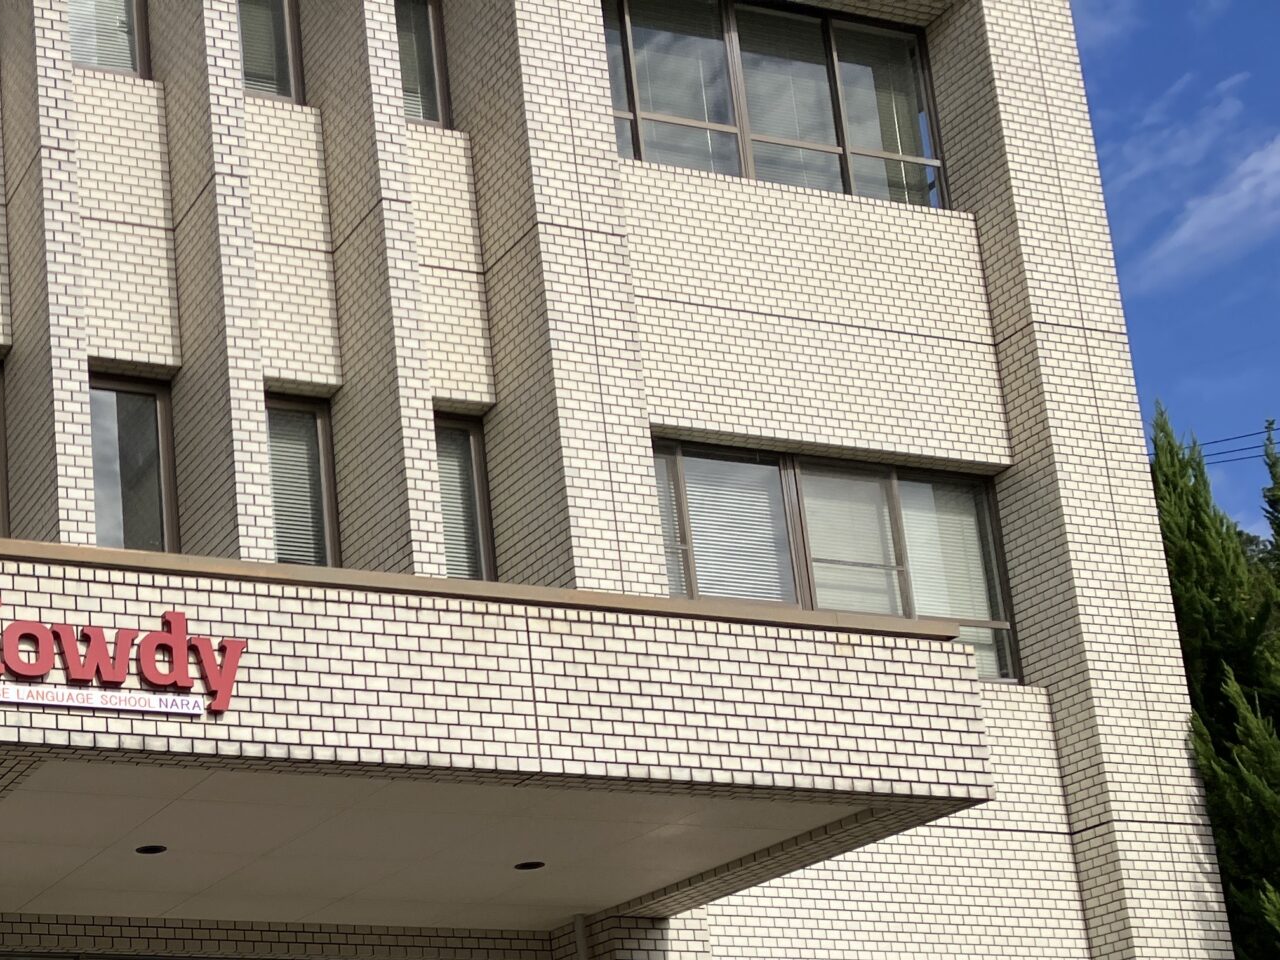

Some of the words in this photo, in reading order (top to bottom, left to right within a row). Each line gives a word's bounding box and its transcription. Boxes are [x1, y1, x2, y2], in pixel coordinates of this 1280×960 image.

[16, 687, 94, 706] LANGUAGE
[100, 694, 156, 709] SCHOOL
[158, 697, 202, 711] NARA
